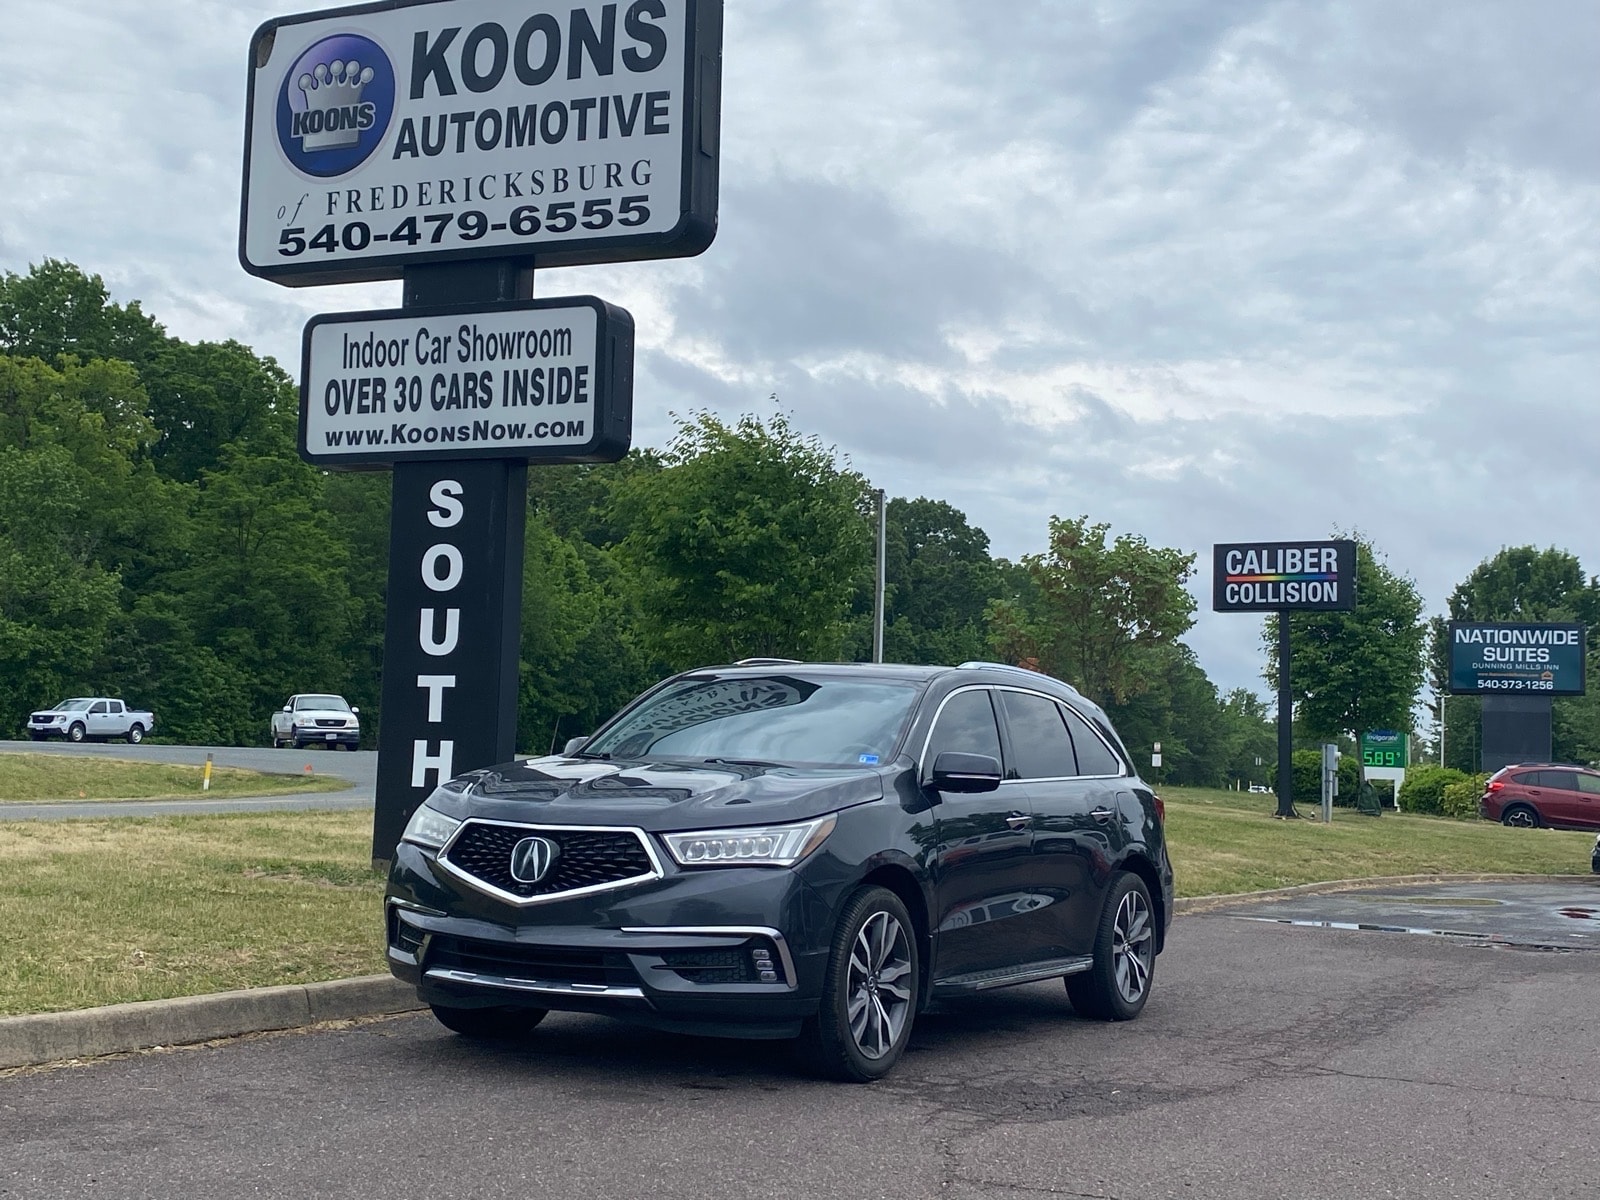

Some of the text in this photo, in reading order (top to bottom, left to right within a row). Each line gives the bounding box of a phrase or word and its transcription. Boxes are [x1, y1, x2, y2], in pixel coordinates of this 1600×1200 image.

[409, 0, 668, 100] KOONS
[293, 103, 375, 136] KOONS
[392, 90, 671, 160] AUTOMOTIVE
[277, 158, 653, 227] of FREDERICKSBURG
[278, 194, 651, 257] 540-479-6555
[343, 324, 572, 369] Indoor Car Showroom
[325, 365, 589, 416] OVER 30 CARS INSIDE
[1226, 548, 1338, 575] CALIBER
[1226, 582, 1338, 604] COLLISION
[1455, 629, 1579, 645] NATIONWIDE
[1472, 662, 1513, 670] DUNNING
[1483, 647, 1550, 662] SUITES
[1477, 679, 1554, 690] 540-373-1256
